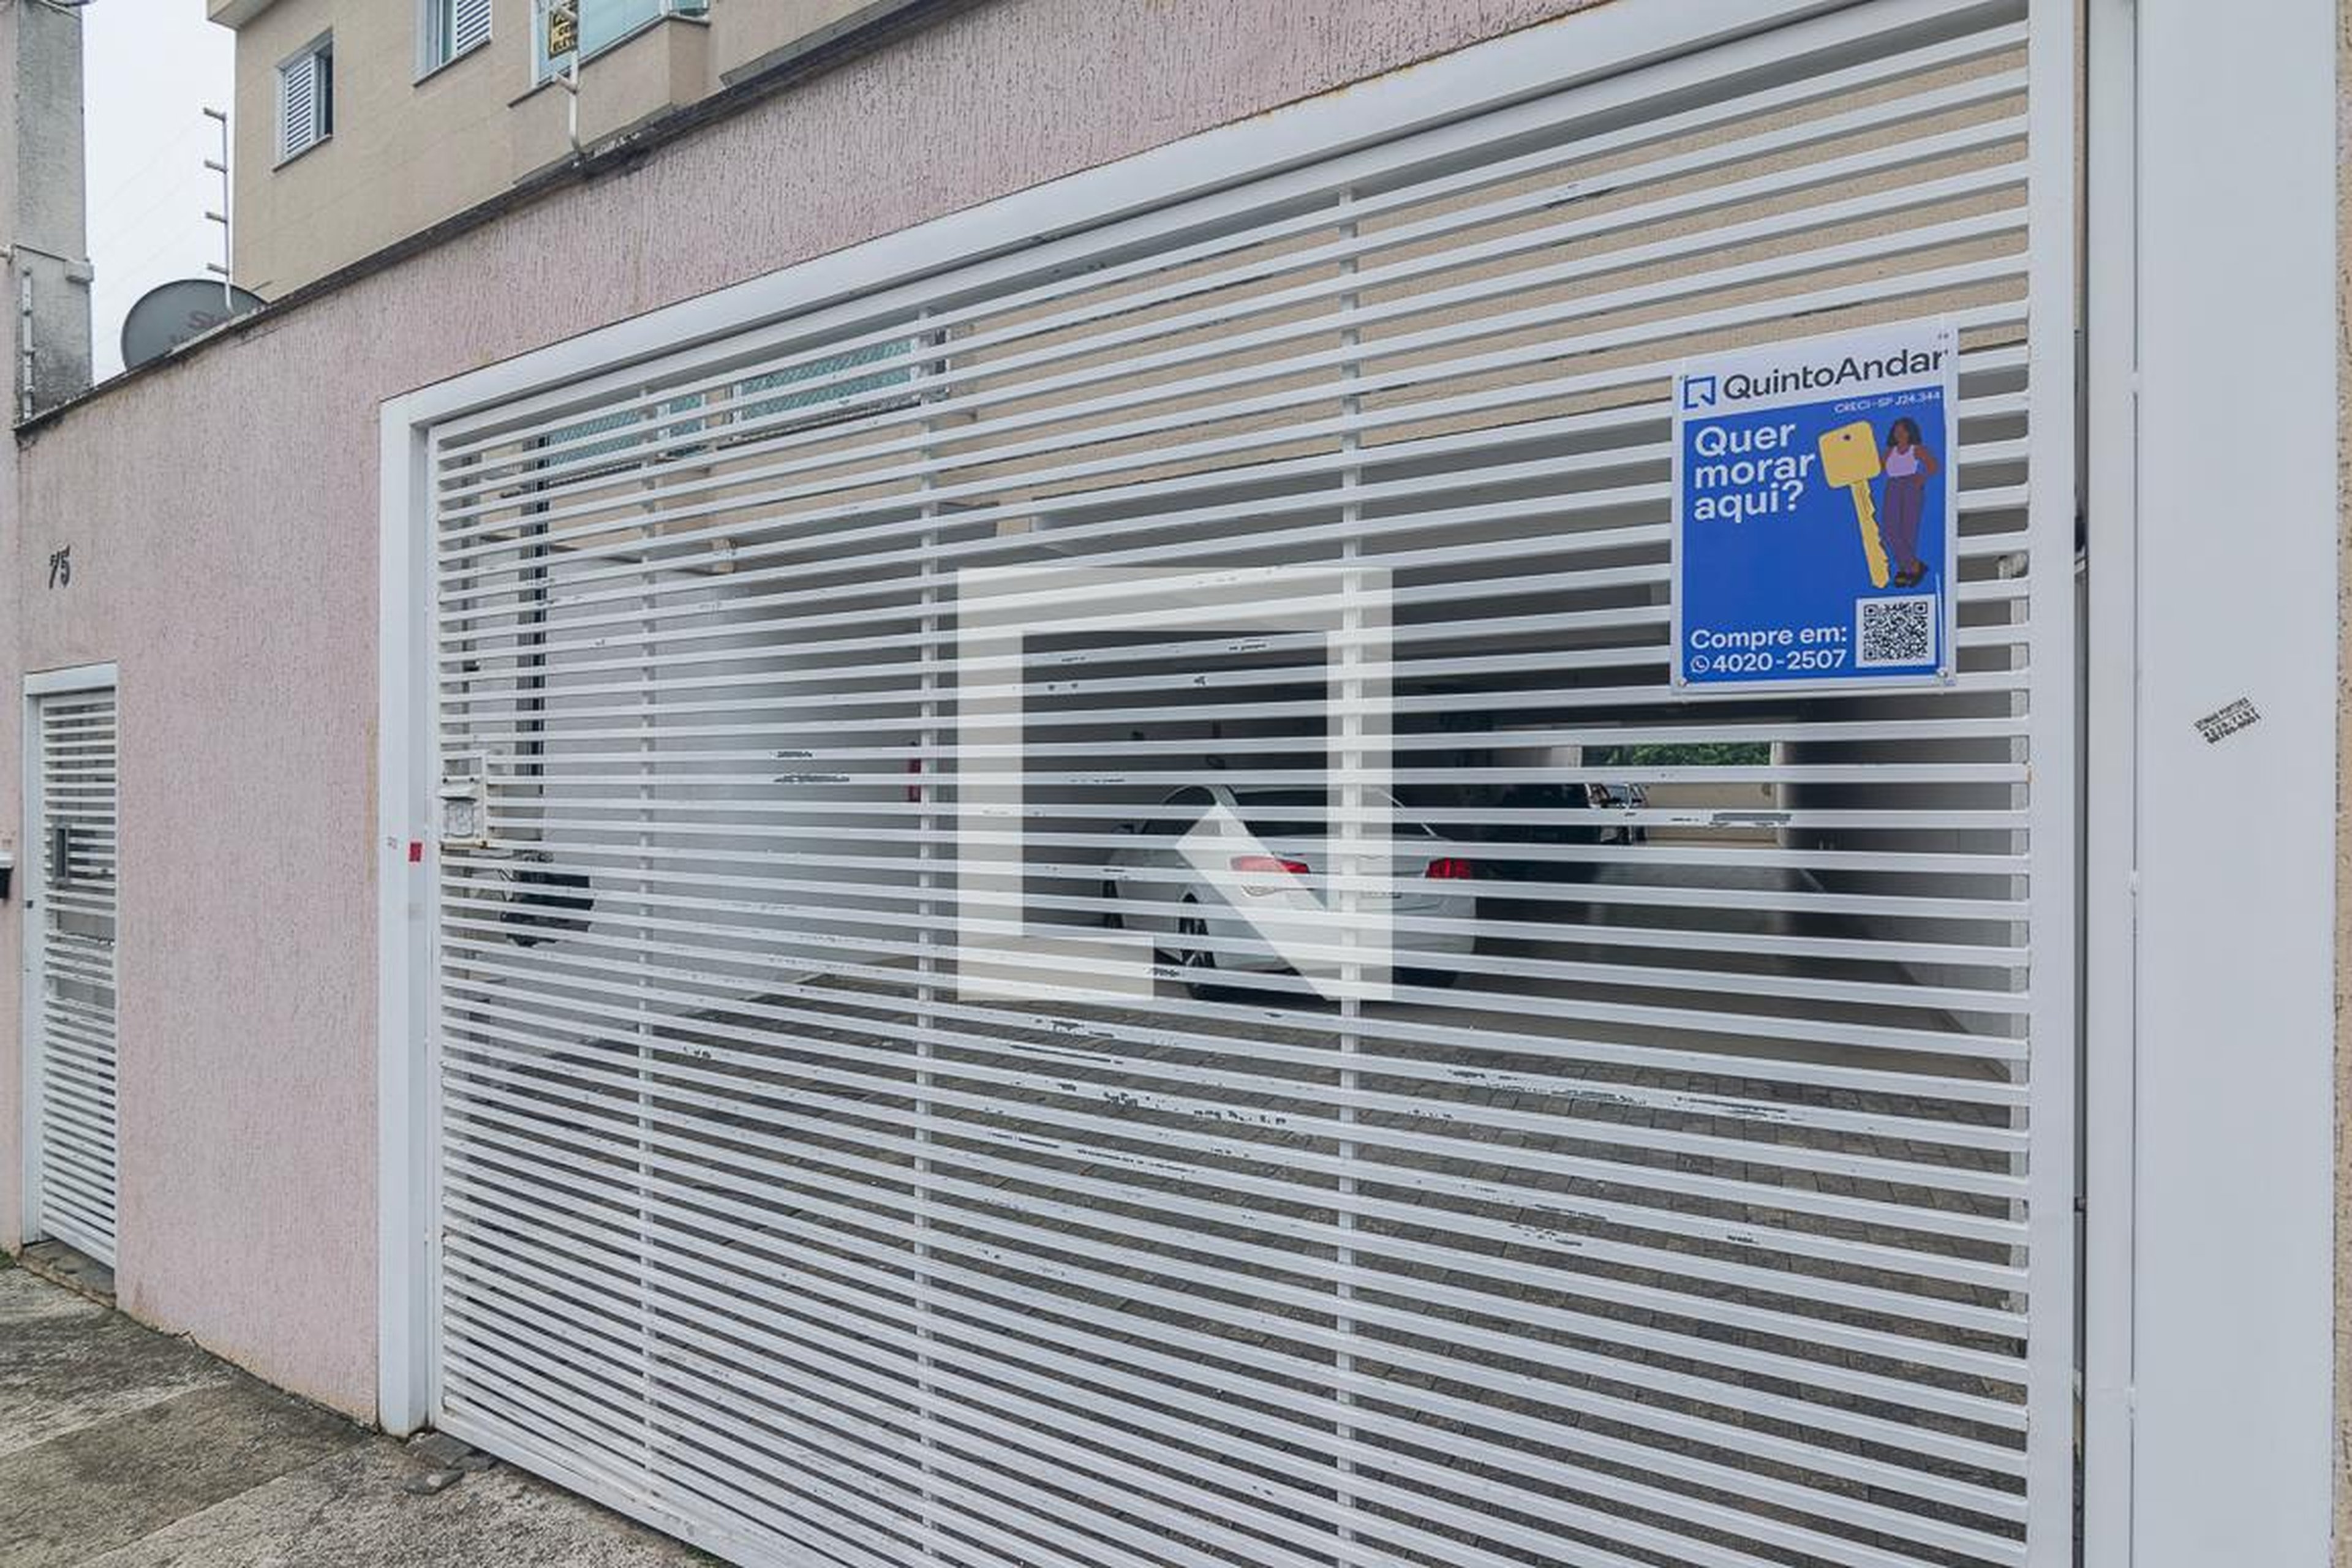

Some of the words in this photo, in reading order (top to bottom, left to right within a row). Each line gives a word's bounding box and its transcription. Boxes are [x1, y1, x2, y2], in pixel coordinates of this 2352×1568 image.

[1723, 349, 1943, 400] QuintoAndar
[1694, 423, 1796, 458] Quer
[1694, 452, 1815, 489] morar
[1694, 481, 1804, 524] aqui?
[49, 544, 70, 589] 75
[1691, 628, 1793, 652] Compre
[1800, 626, 1847, 643] em:
[1712, 649, 1847, 673] 4020-2507
